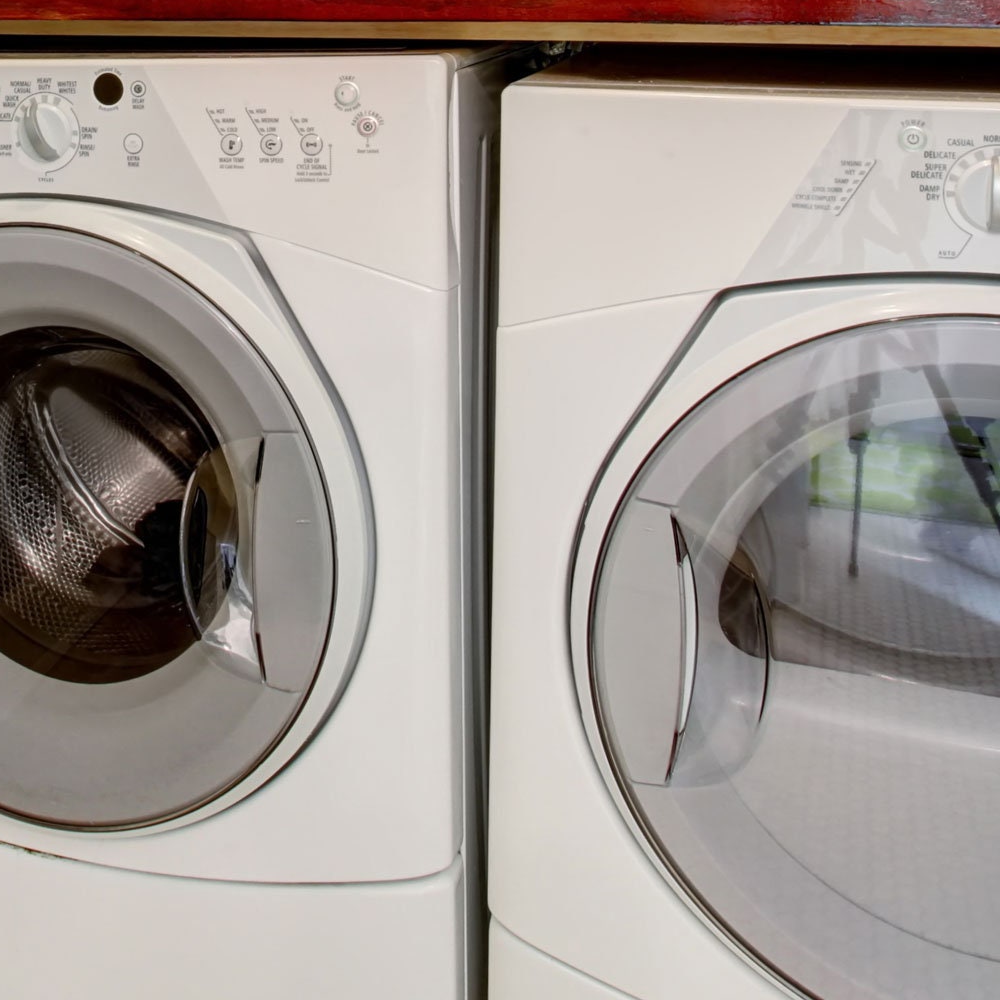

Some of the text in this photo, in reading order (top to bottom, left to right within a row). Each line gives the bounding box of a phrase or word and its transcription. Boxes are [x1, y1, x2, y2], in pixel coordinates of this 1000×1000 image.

[900, 119, 926, 127] POWER
[947, 138, 975, 147] CASUAL
[983, 134, 1000, 143] NOR
[924, 151, 957, 160] DELICATE
[925, 163, 947, 171] SUPER
[911, 171, 944, 179] DELICATE
[919, 184, 940, 192] DAMP
[926, 193, 940, 201] DRY
